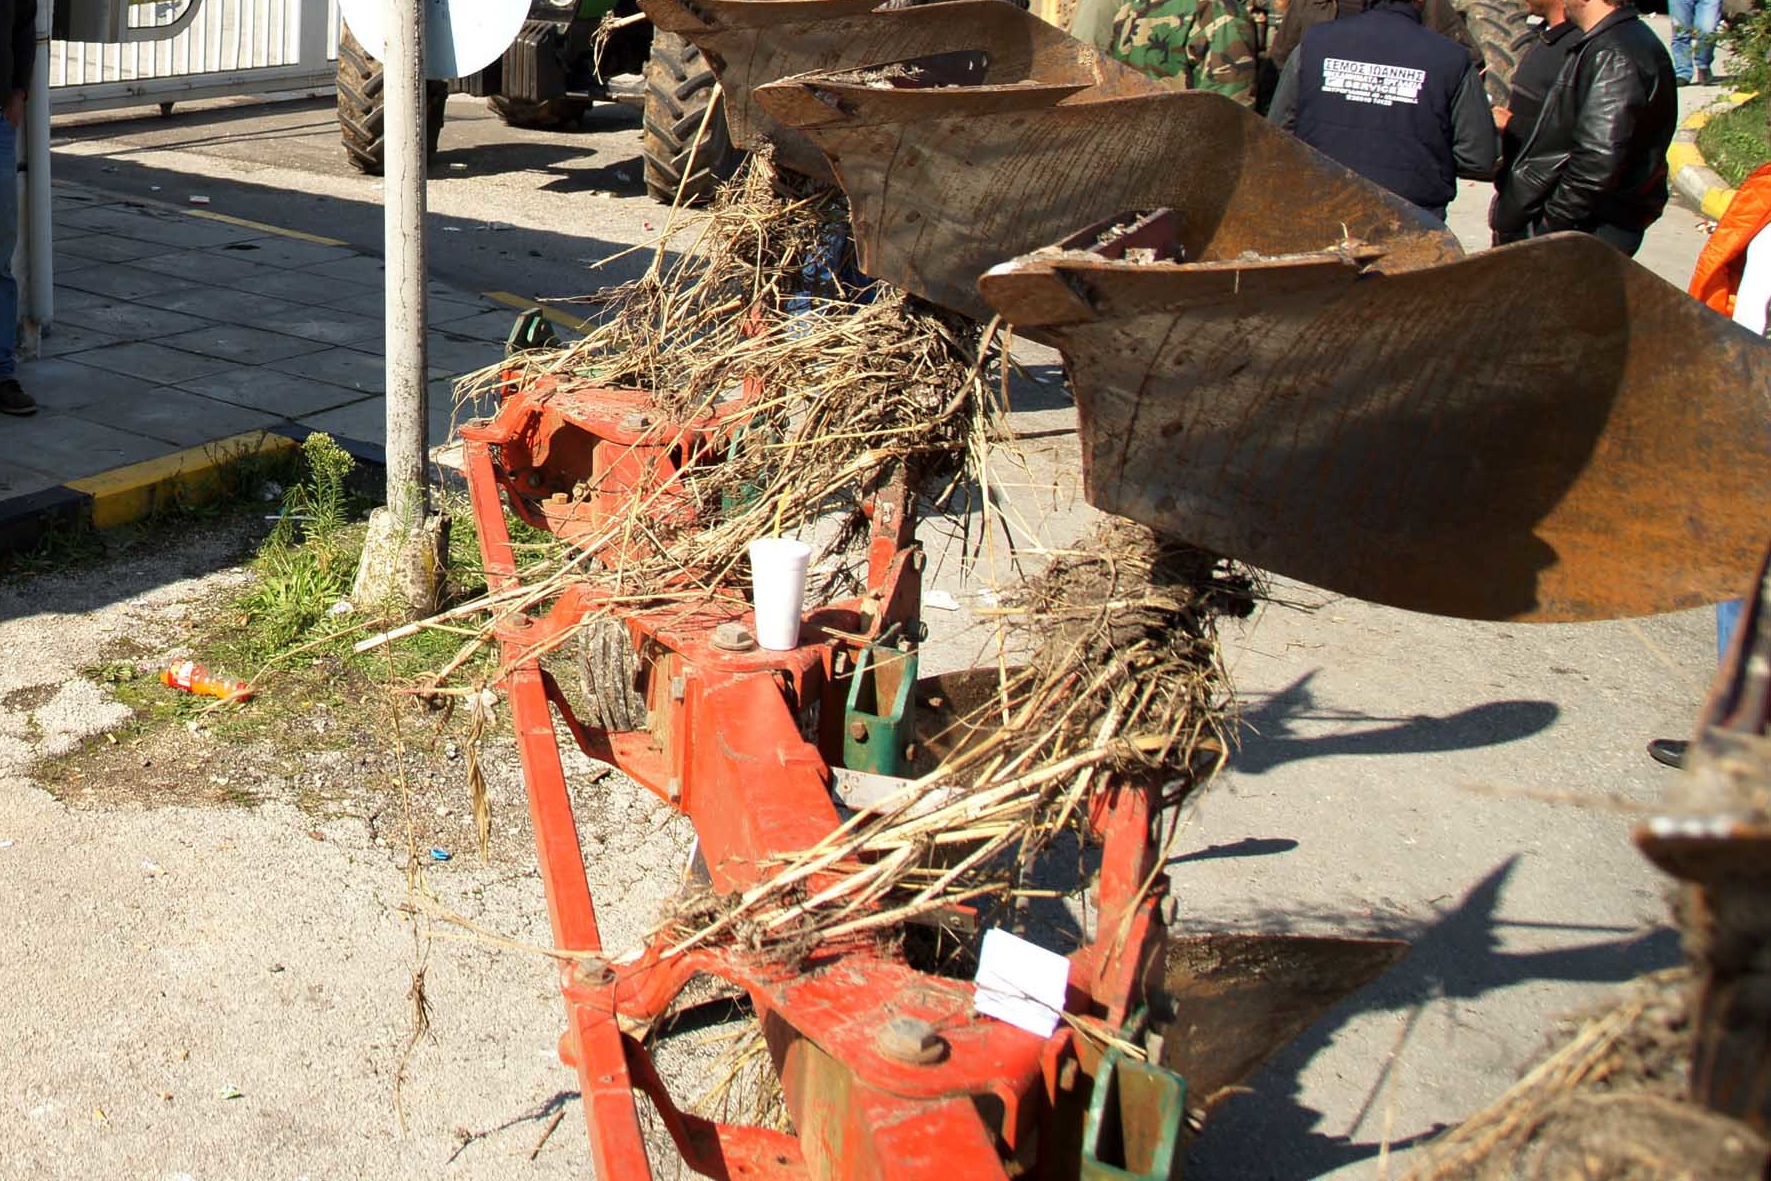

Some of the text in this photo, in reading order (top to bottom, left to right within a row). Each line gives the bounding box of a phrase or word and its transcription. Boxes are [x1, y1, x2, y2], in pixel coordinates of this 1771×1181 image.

[1325, 59, 1424, 83] ΣΕΜΟΣ ΙΩΑΝΝΗΣ
[1345, 79, 1397, 95] SERVICE
